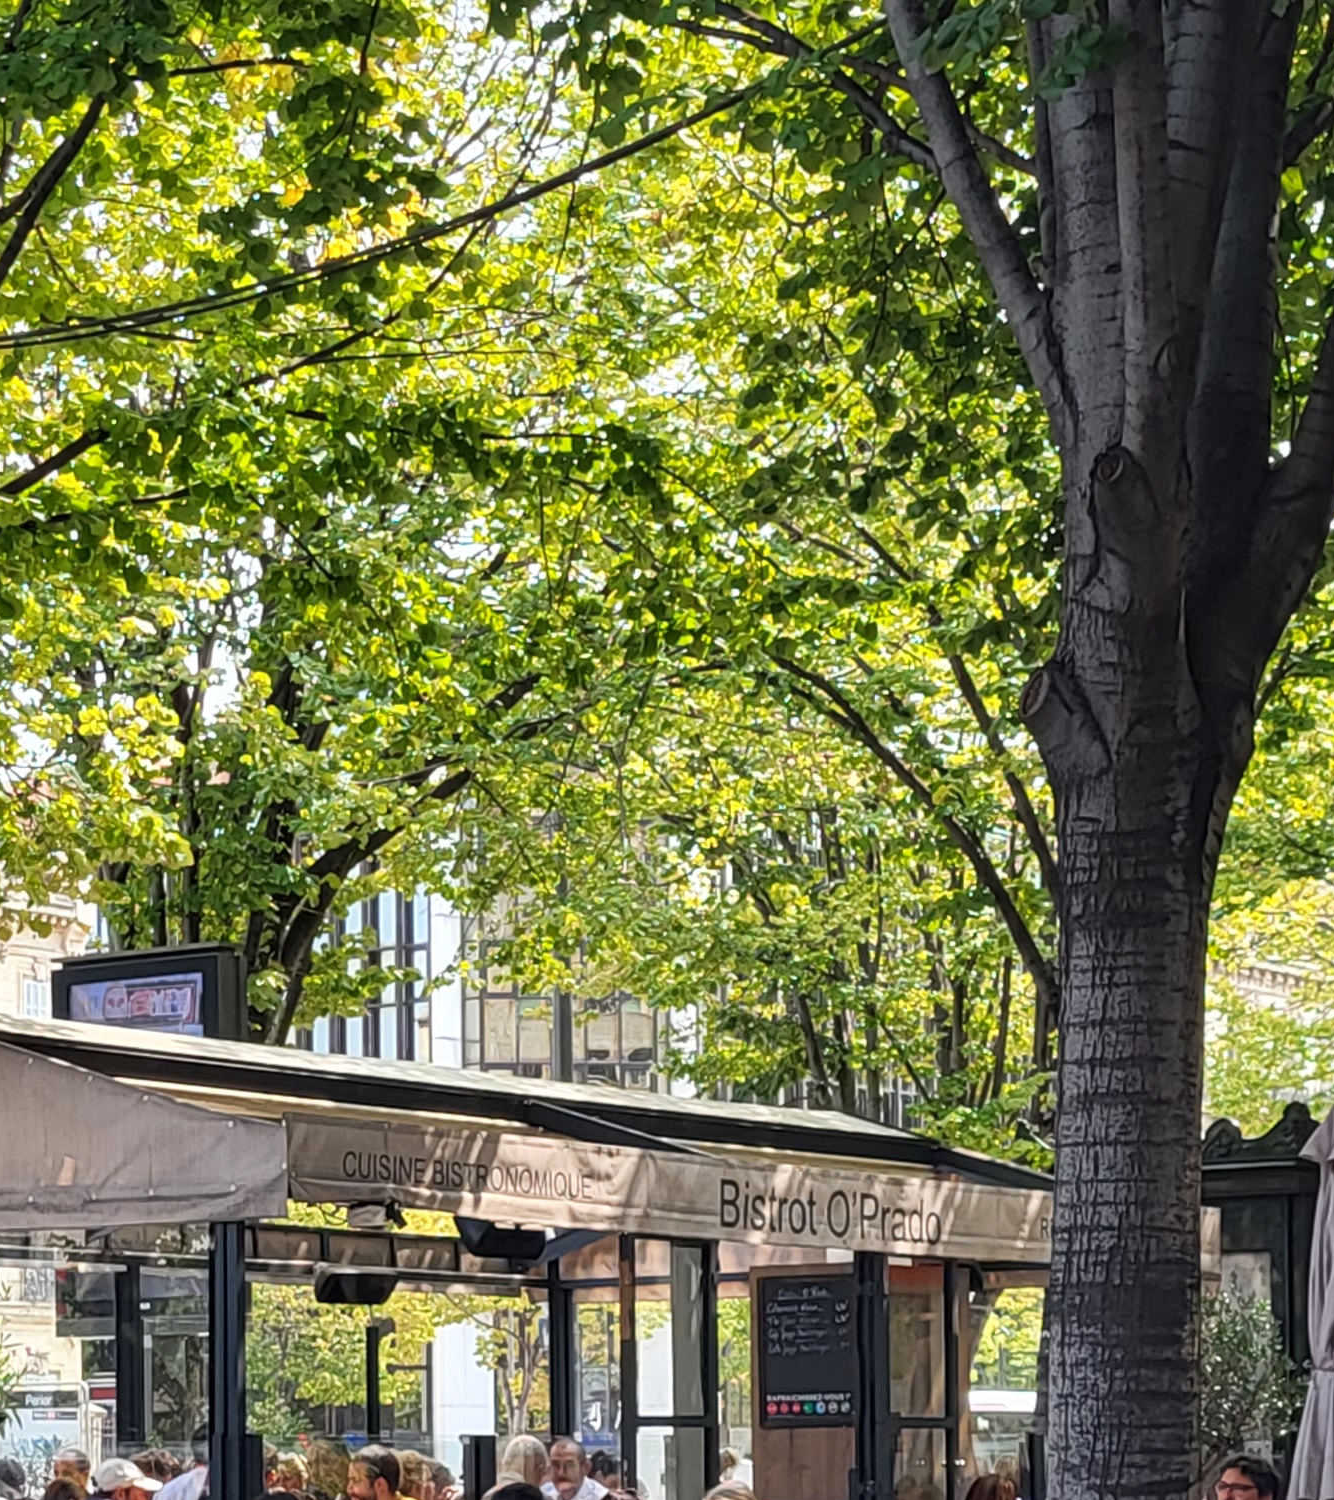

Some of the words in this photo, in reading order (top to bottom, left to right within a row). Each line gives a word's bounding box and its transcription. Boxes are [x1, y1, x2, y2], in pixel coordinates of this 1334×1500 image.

[342, 1151, 427, 1184] CUISINE
[432, 1160, 595, 1200] BISTRONOMIQUE
[719, 1178, 817, 1236] Bistrot
[826, 1189, 942, 1246] O'Prado
